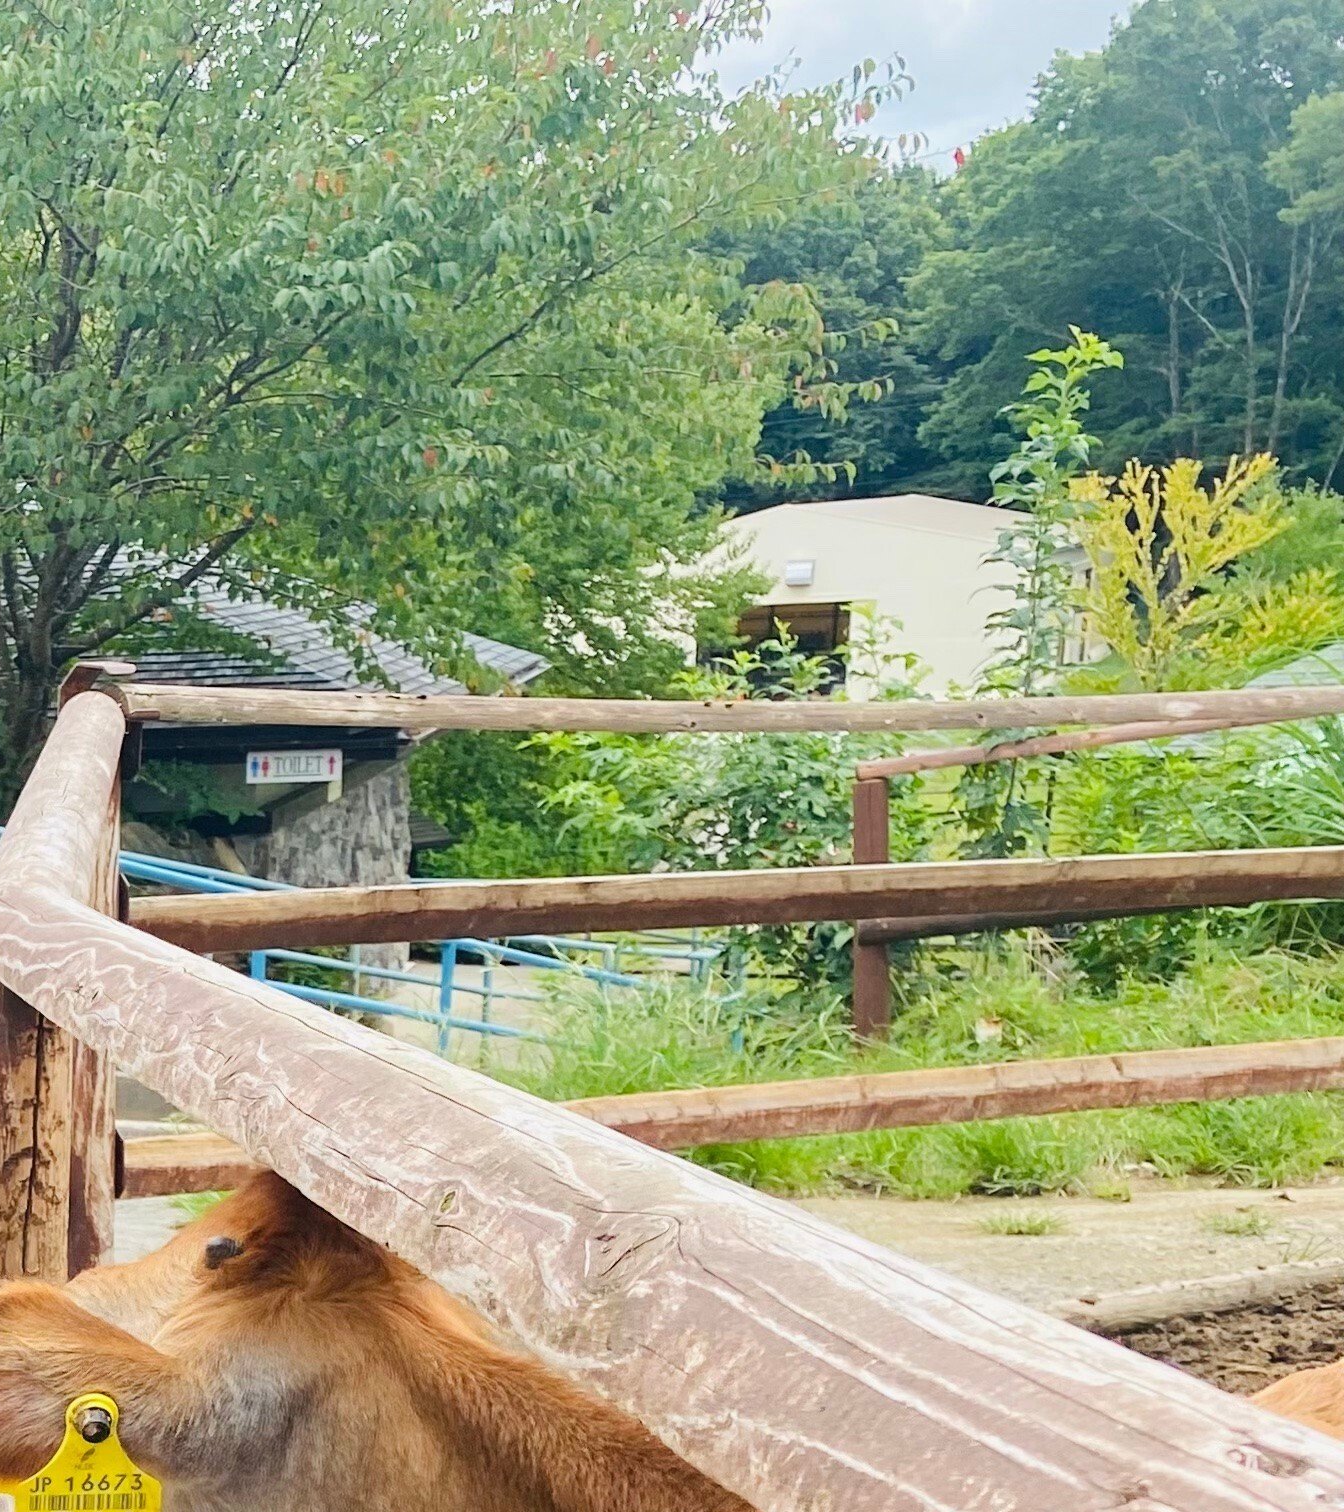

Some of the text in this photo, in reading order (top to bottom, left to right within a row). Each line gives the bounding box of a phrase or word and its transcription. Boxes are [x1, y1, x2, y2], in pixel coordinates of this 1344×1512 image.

[274, 756, 323, 774] TOILET
[30, 1473, 143, 1493] JP 16673
